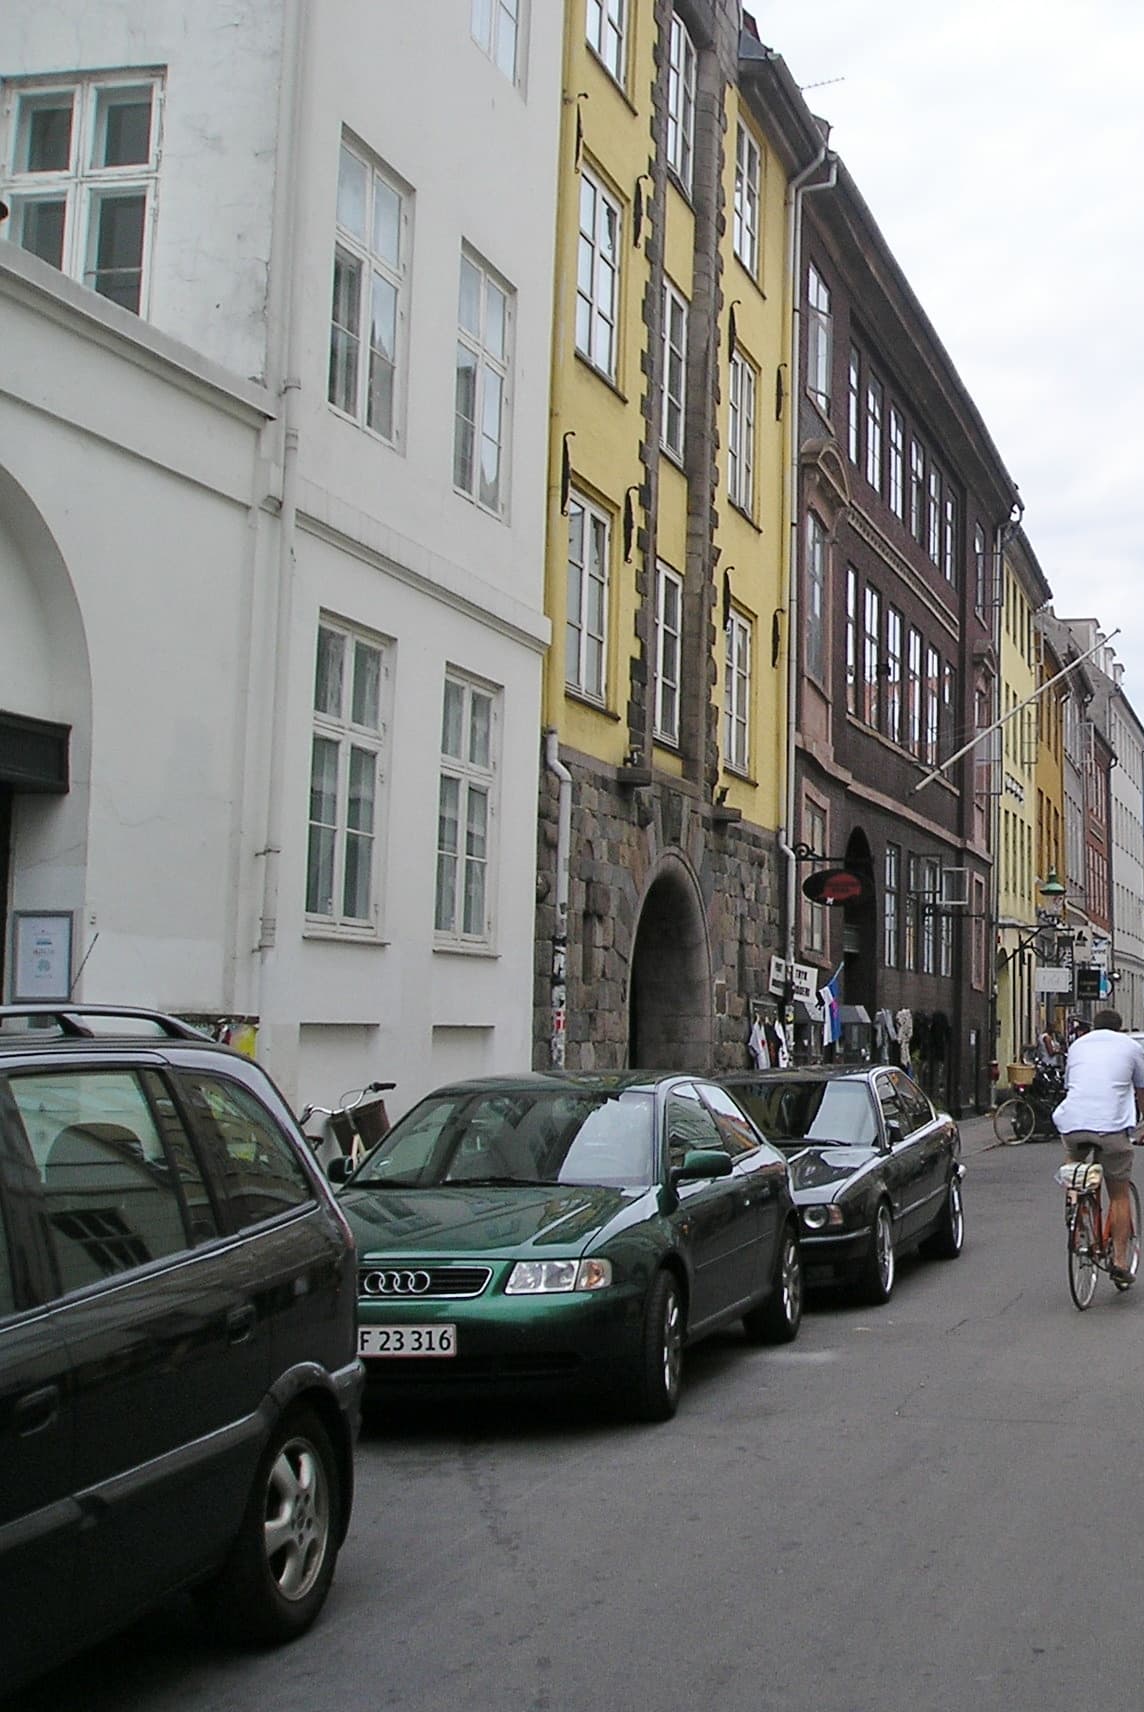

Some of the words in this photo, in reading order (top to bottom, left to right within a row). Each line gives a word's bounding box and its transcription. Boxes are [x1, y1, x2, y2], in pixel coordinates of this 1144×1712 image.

[359, 1330, 372, 1351] F
[379, 1330, 405, 1351] 23
[411, 1329, 451, 1351] 316
